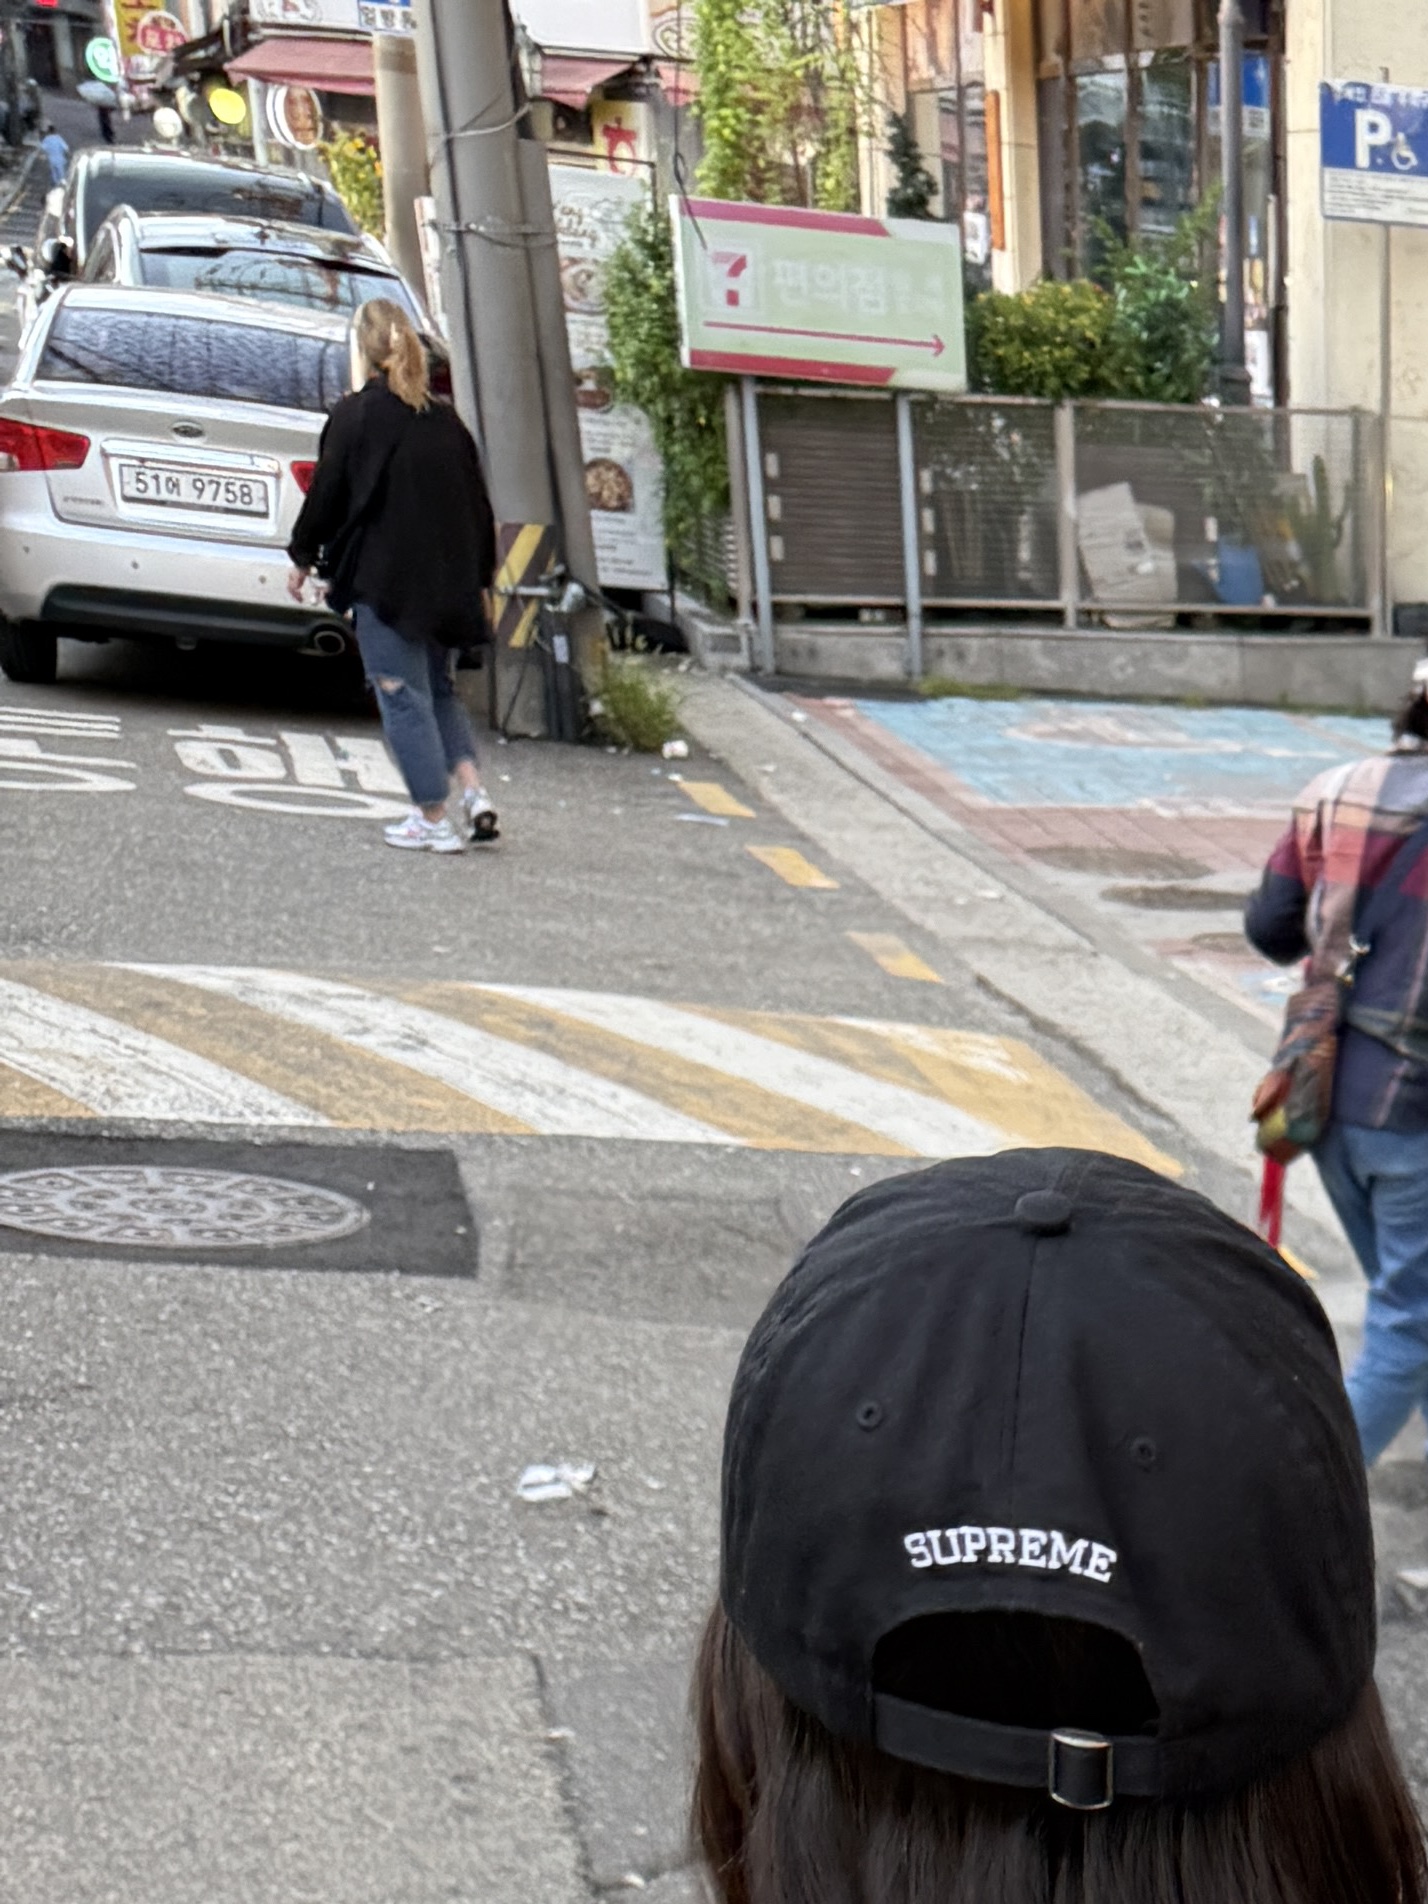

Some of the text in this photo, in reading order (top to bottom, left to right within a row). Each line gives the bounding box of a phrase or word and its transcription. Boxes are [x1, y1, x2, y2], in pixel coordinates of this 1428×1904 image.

[1355, 108, 1392, 169] P
[771, 258, 887, 317] 편의점
[191, 478, 253, 506] 9758
[903, 1525, 1118, 1583] SUPREME
